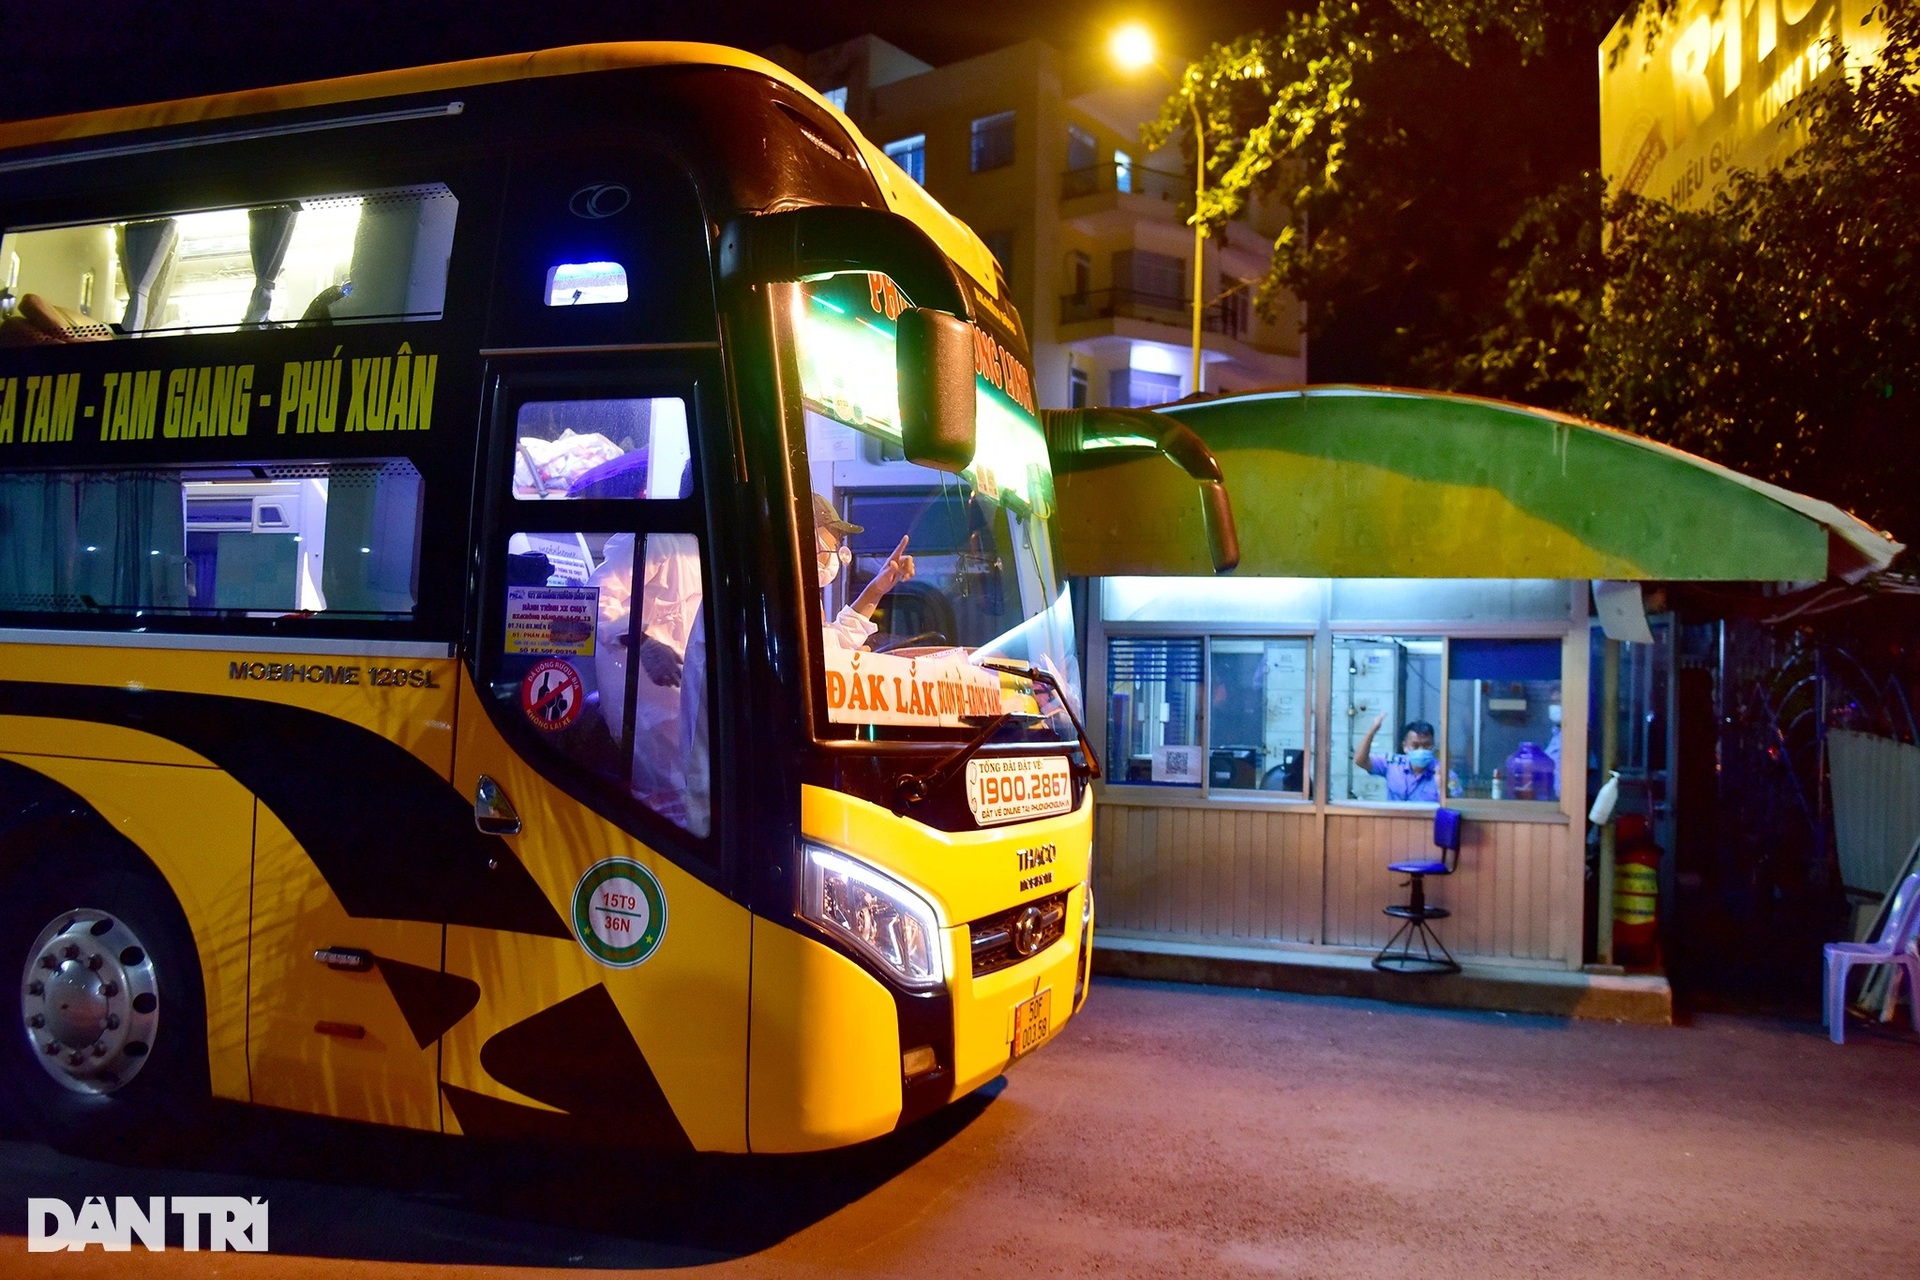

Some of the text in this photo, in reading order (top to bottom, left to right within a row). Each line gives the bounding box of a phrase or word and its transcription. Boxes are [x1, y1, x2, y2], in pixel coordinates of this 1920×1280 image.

[22, 372, 81, 443] TAM
[99, 370, 162, 441] TAM
[162, 364, 256, 439] GIANG
[277, 344, 343, 435] PHÚ
[344, 341, 439, 432] XUÂN
[229, 661, 440, 688] MOBIHOME 120SL
[571, 676, 580, 690] BIA
[826, 652, 938, 716] ĐẮK LẮK
[563, 716, 572, 726] XE
[979, 760, 1001, 773] TỔNG
[1003, 760, 1016, 771] ĐÀI
[980, 772, 1068, 805] 1900.2867
[1016, 843, 1056, 872] THACO
[603, 892, 636, 910] 15T9
[604, 916, 631, 933] 36N
[1029, 997, 1043, 1022] 50F
